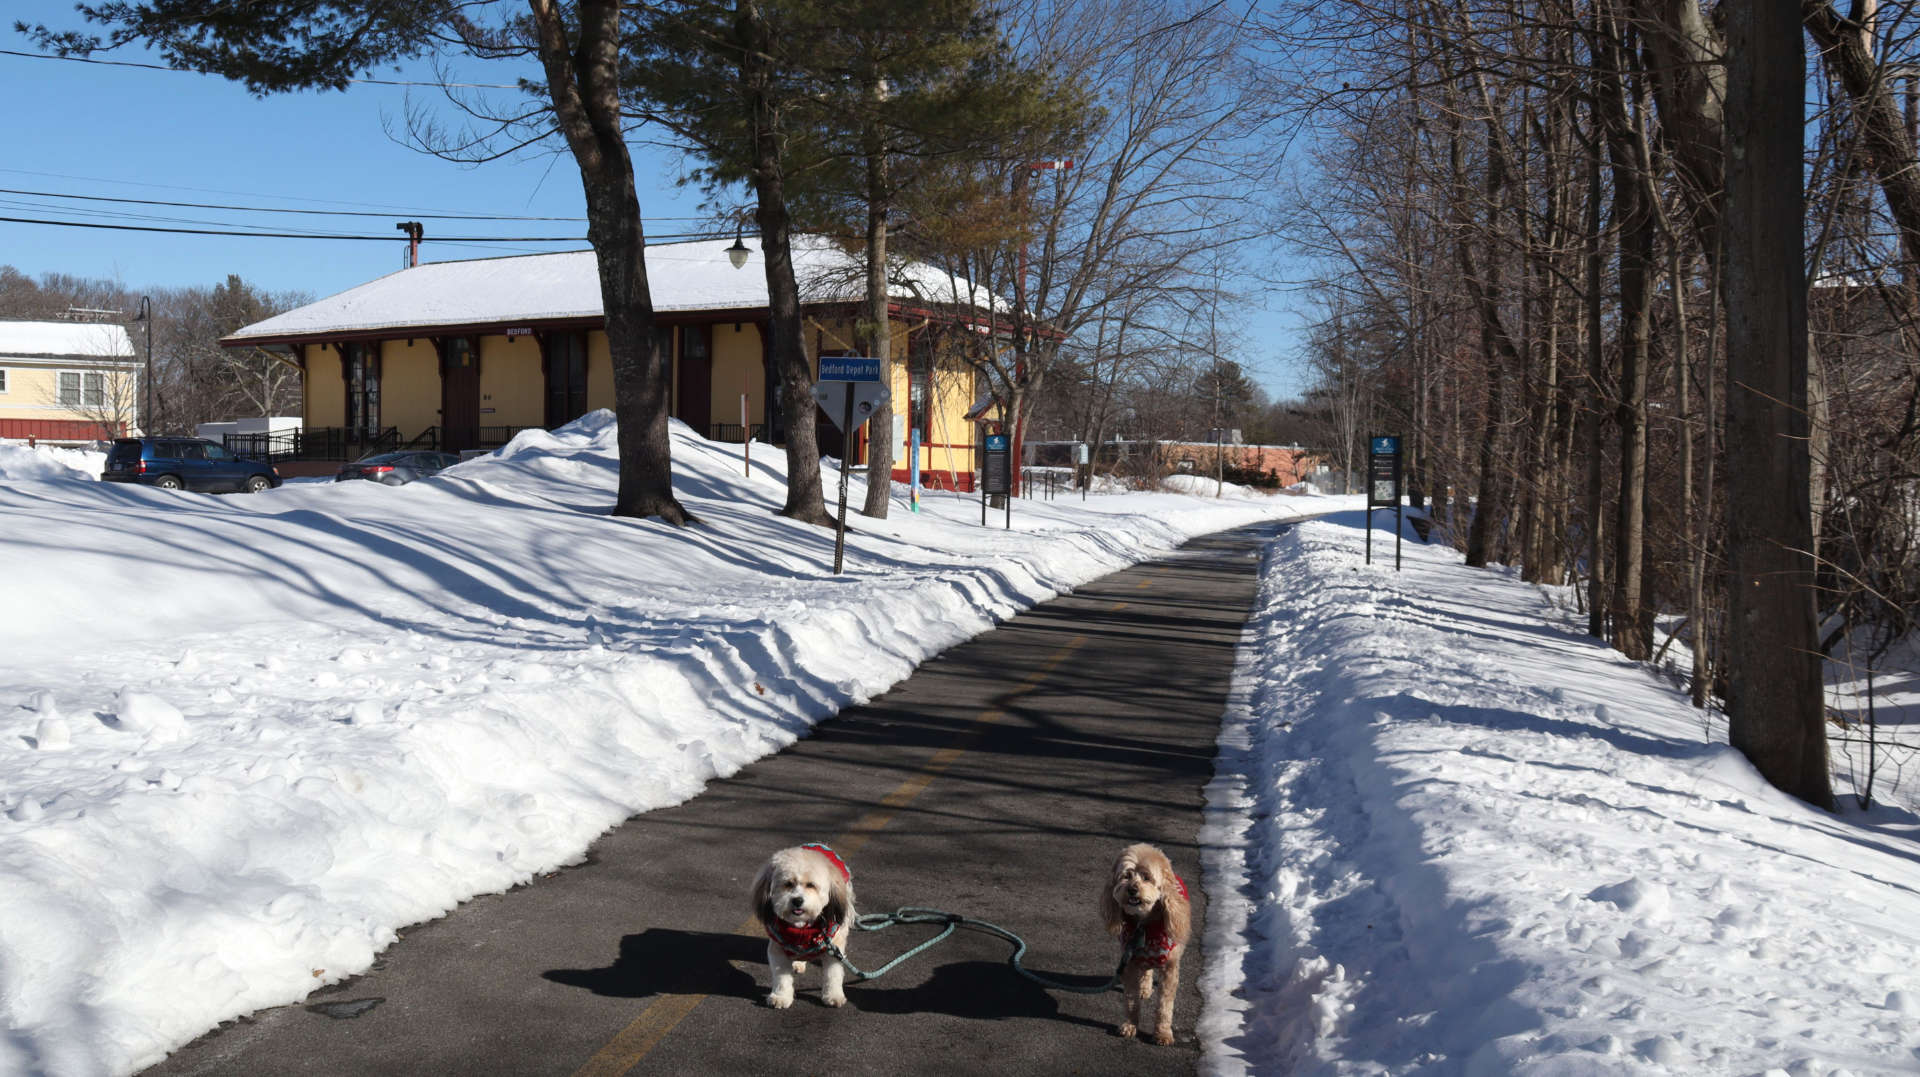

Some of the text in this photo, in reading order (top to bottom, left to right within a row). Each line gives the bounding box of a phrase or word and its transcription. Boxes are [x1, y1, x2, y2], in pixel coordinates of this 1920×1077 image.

[821, 363, 879, 376] Bedford Depot Park
